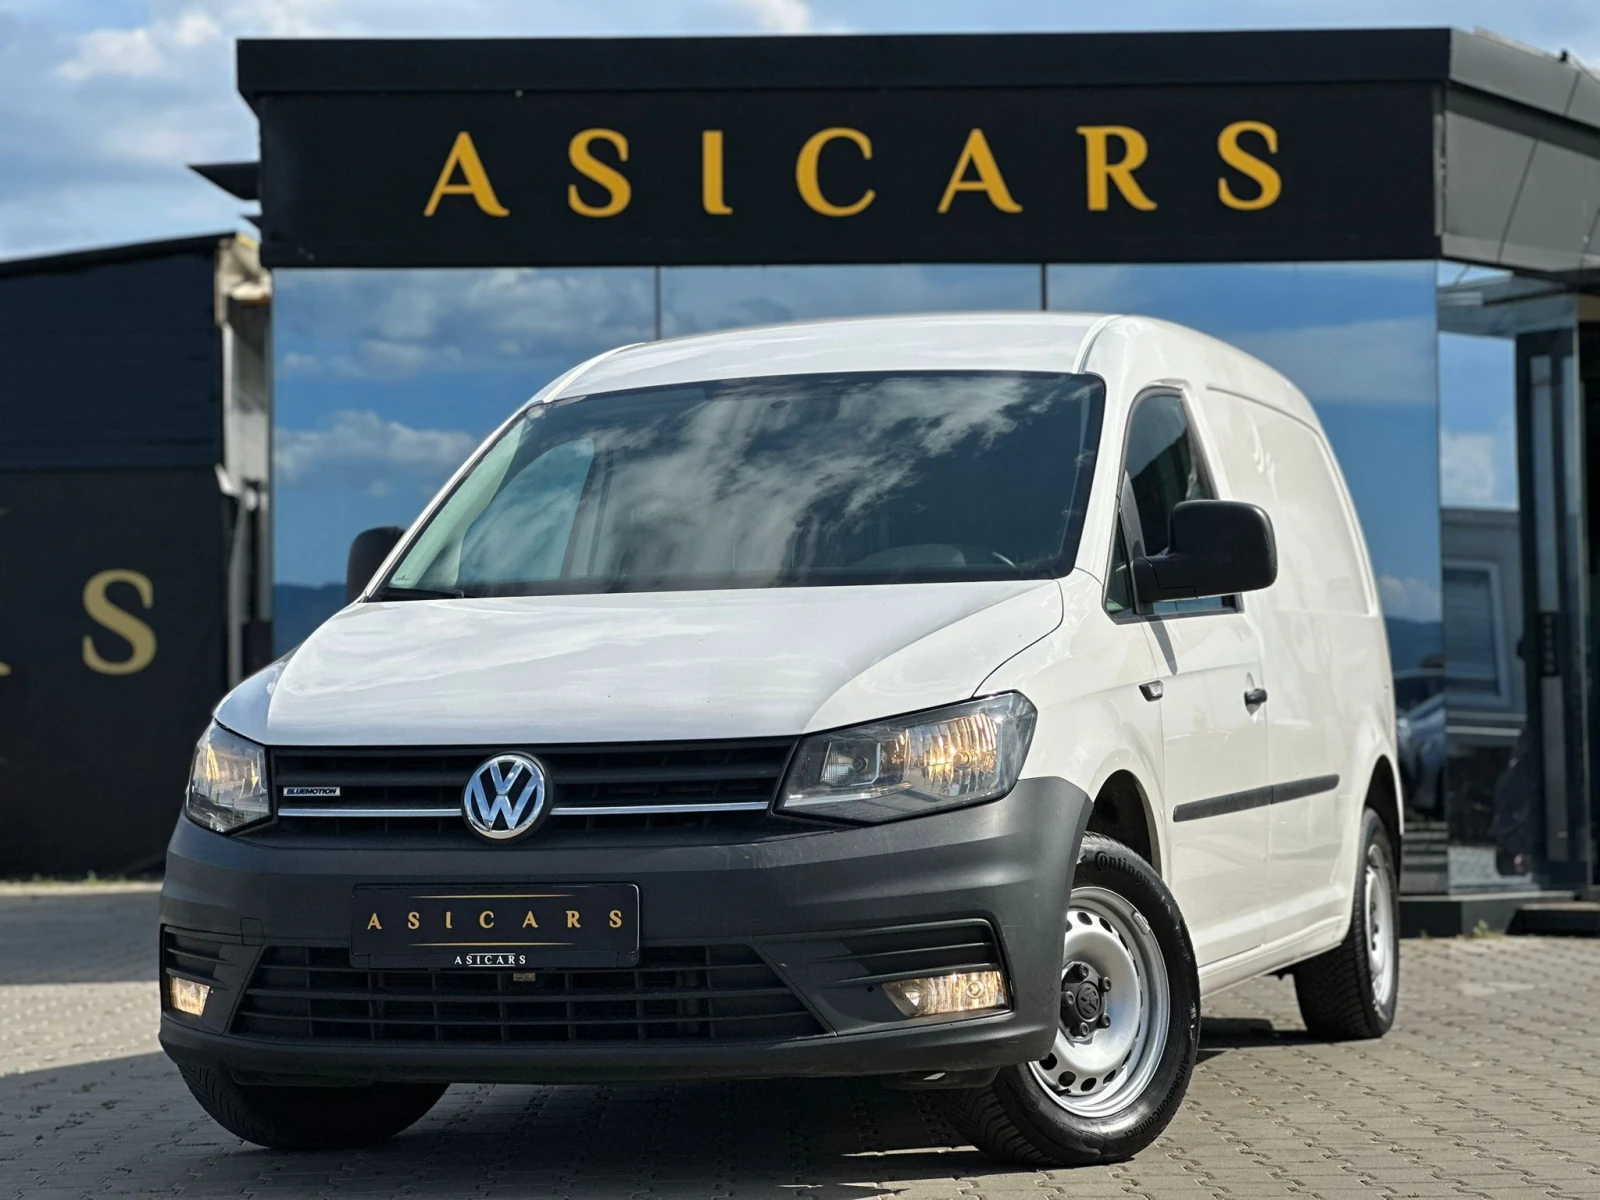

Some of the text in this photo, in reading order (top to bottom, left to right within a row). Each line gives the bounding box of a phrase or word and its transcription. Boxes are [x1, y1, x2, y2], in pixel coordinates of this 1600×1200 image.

[424, 121, 1282, 218] ASICARS
[286, 787, 338, 795] BLUEMOTION
[366, 909, 623, 930] ASICARS
[454, 954, 527, 965] ASICARS
